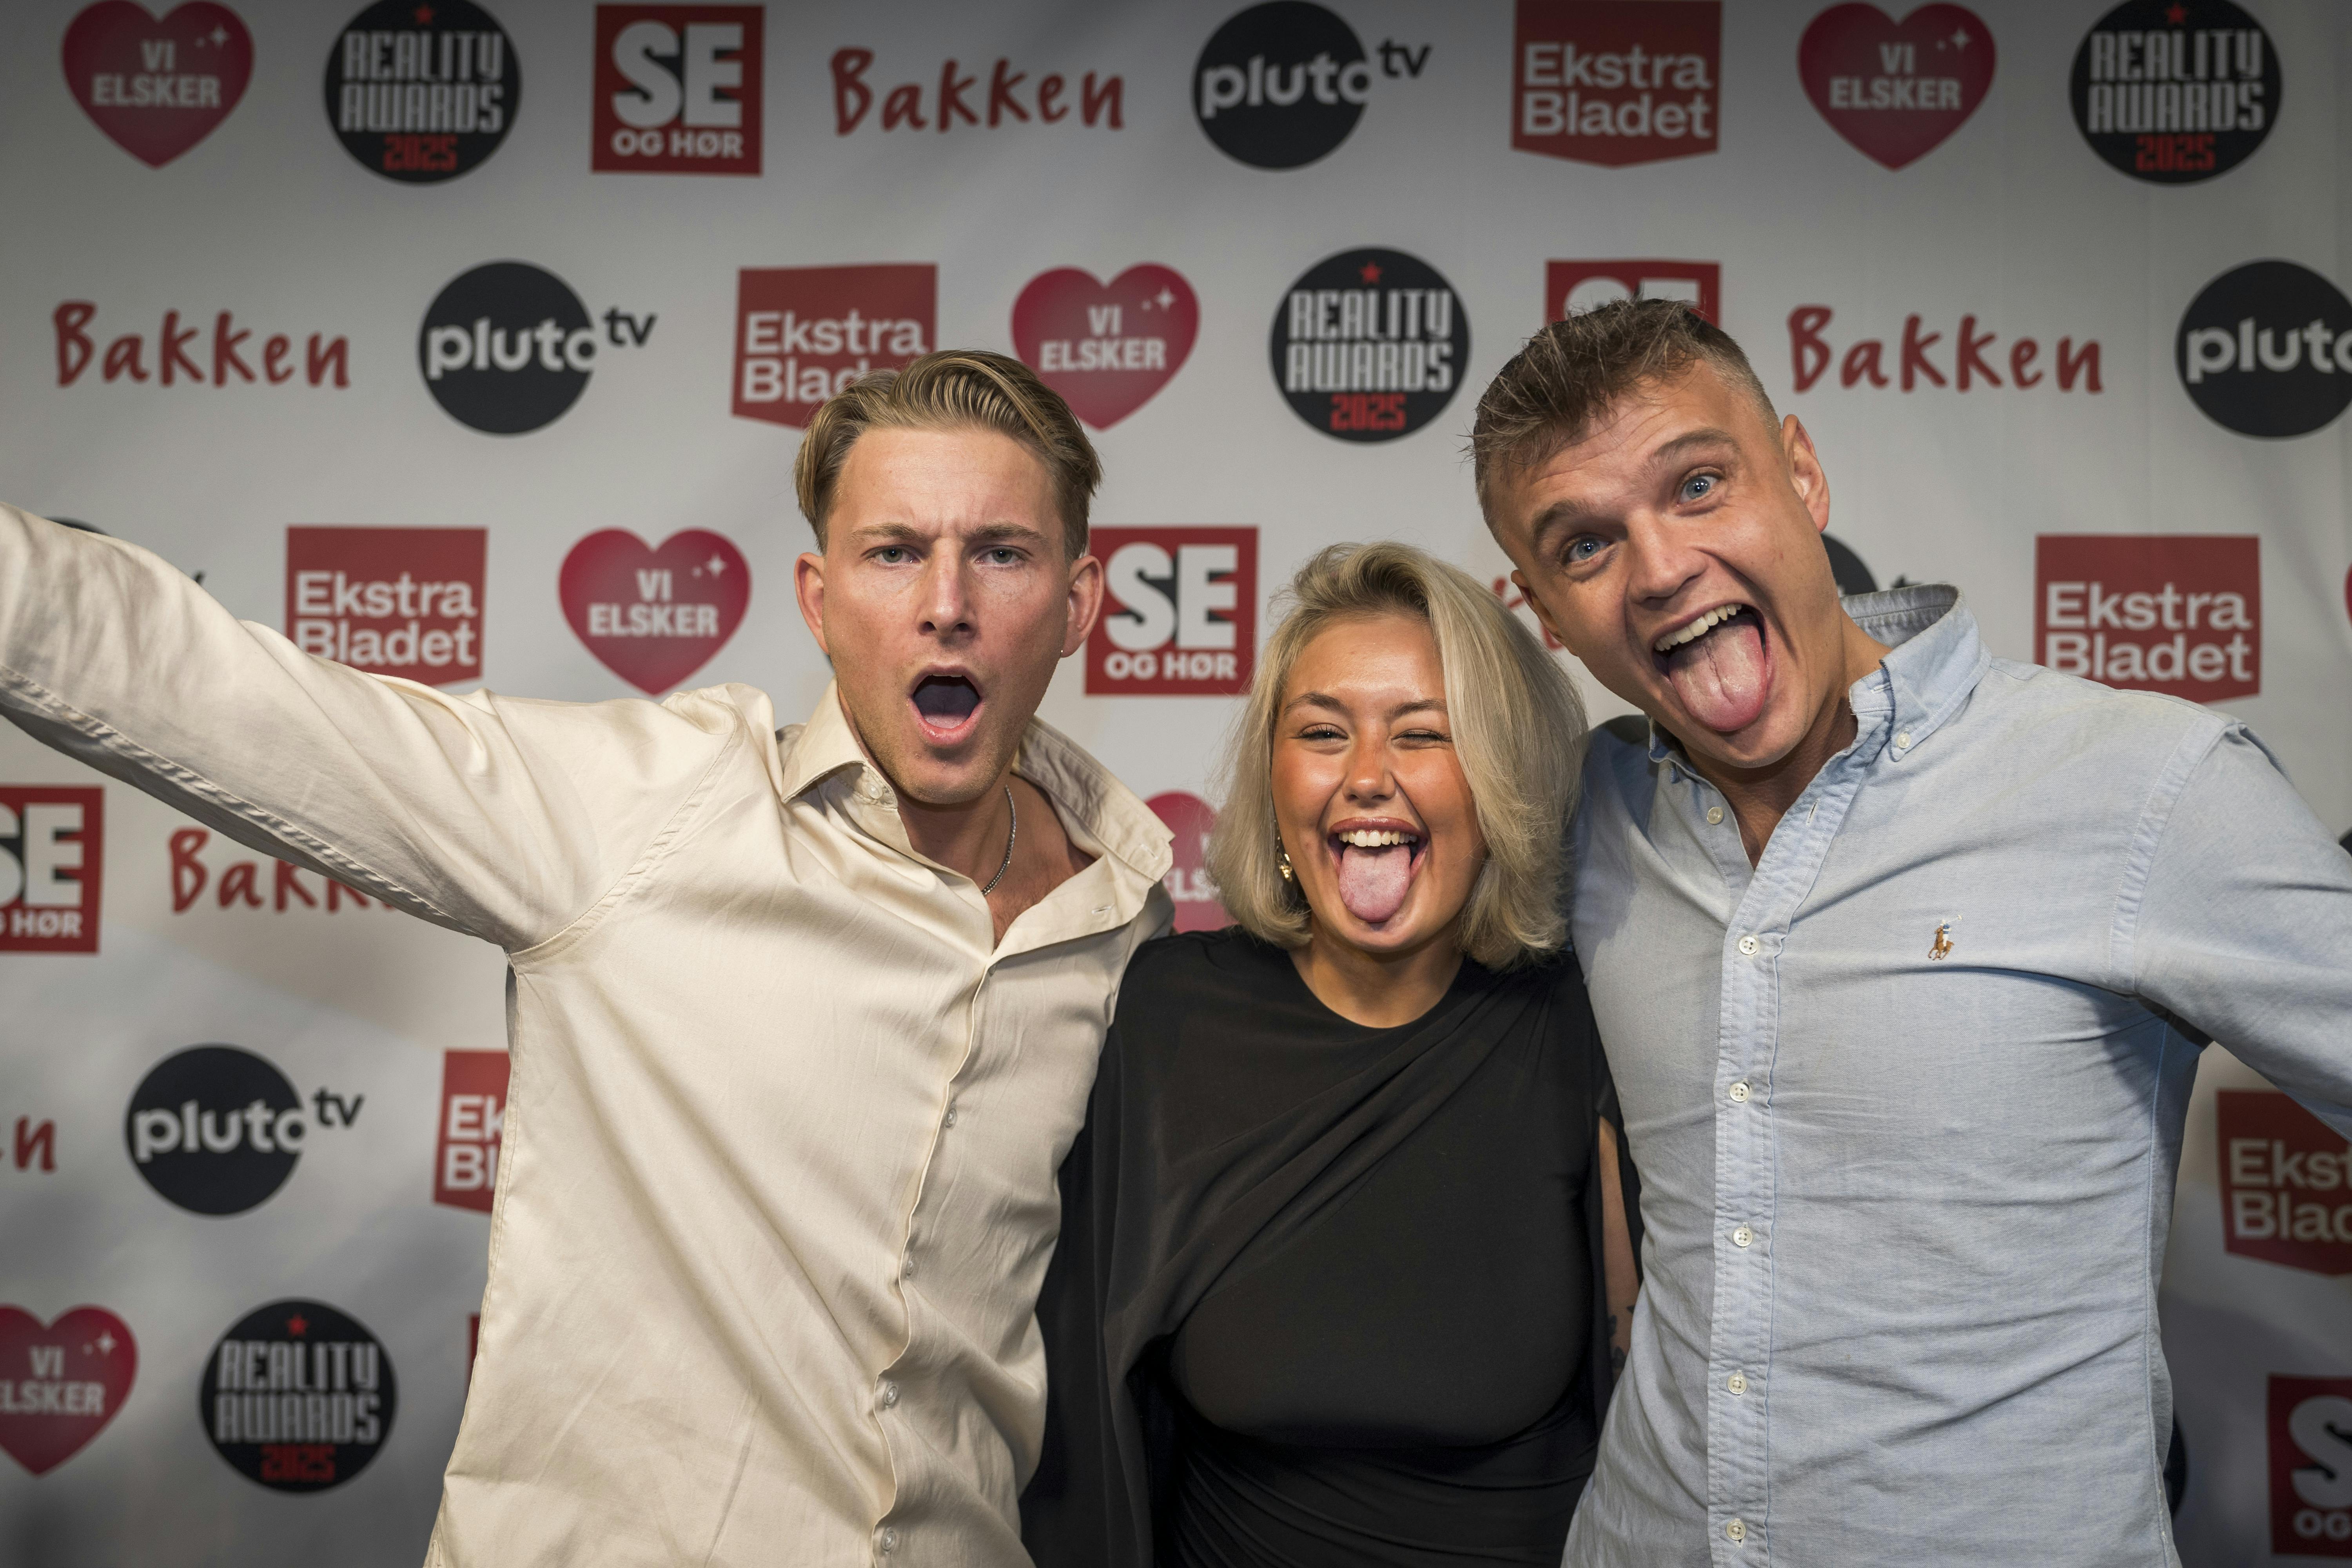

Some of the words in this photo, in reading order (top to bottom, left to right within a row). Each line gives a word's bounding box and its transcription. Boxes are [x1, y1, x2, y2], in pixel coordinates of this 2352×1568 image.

[142, 39, 176, 71] VI
[344, 31, 504, 82] REALITY
[612, 20, 745, 129] SE
[1200, 55, 1372, 118] pluto
[1378, 38, 1432, 80] tv
[1523, 43, 1713, 89] Ekstra
[1880, 42, 1915, 73] VI
[2091, 29, 2262, 81] REALITY
[92, 75, 220, 108] ELSKER
[339, 83, 504, 132] AWARDS
[829, 46, 1125, 136] Bakken
[1830, 77, 1961, 111] ELSKER
[2087, 82, 2266, 133] AWARDS
[1521, 93, 1712, 140] Bladet
[383, 135, 458, 172] 2025
[612, 131, 663, 158] OG
[670, 132, 744, 158] HØR
[2136, 135, 2216, 172] 2025
[745, 308, 929, 355] Ekstra
[1088, 305, 1123, 336] VI
[1290, 290, 1453, 342] REALITY
[52, 300, 351, 390] Bakken
[426, 317, 595, 379] pluto
[604, 307, 659, 347] tv
[1041, 339, 1167, 372] ELSKER
[1286, 343, 1453, 392] AWARDS
[1787, 304, 2105, 394] Bakken
[1331, 394, 1406, 431] 2025
[296, 570, 476, 619] Ekstra
[637, 569, 672, 602] VI
[1105, 541, 1238, 651] SE
[2045, 580, 2254, 630] Ekstra
[296, 619, 476, 666] Bladet
[589, 604, 718, 637] ELSKER
[1104, 652, 1157, 681] OG
[1163, 653, 1237, 681] HØR
[2044, 632, 2254, 682] Bladet
[0, 802, 85, 909] E
[133, 1100, 308, 1162] pluto
[313, 1088, 365, 1128] tv
[28, 1344, 65, 1378] VI
[218, 1341, 379, 1392] REALITY
[0, 1379, 105, 1416] LSKER
[214, 1393, 380, 1443] AWARDS
[261, 1446, 336, 1482] 2025
[2287, 1394, 2352, 1508] S
